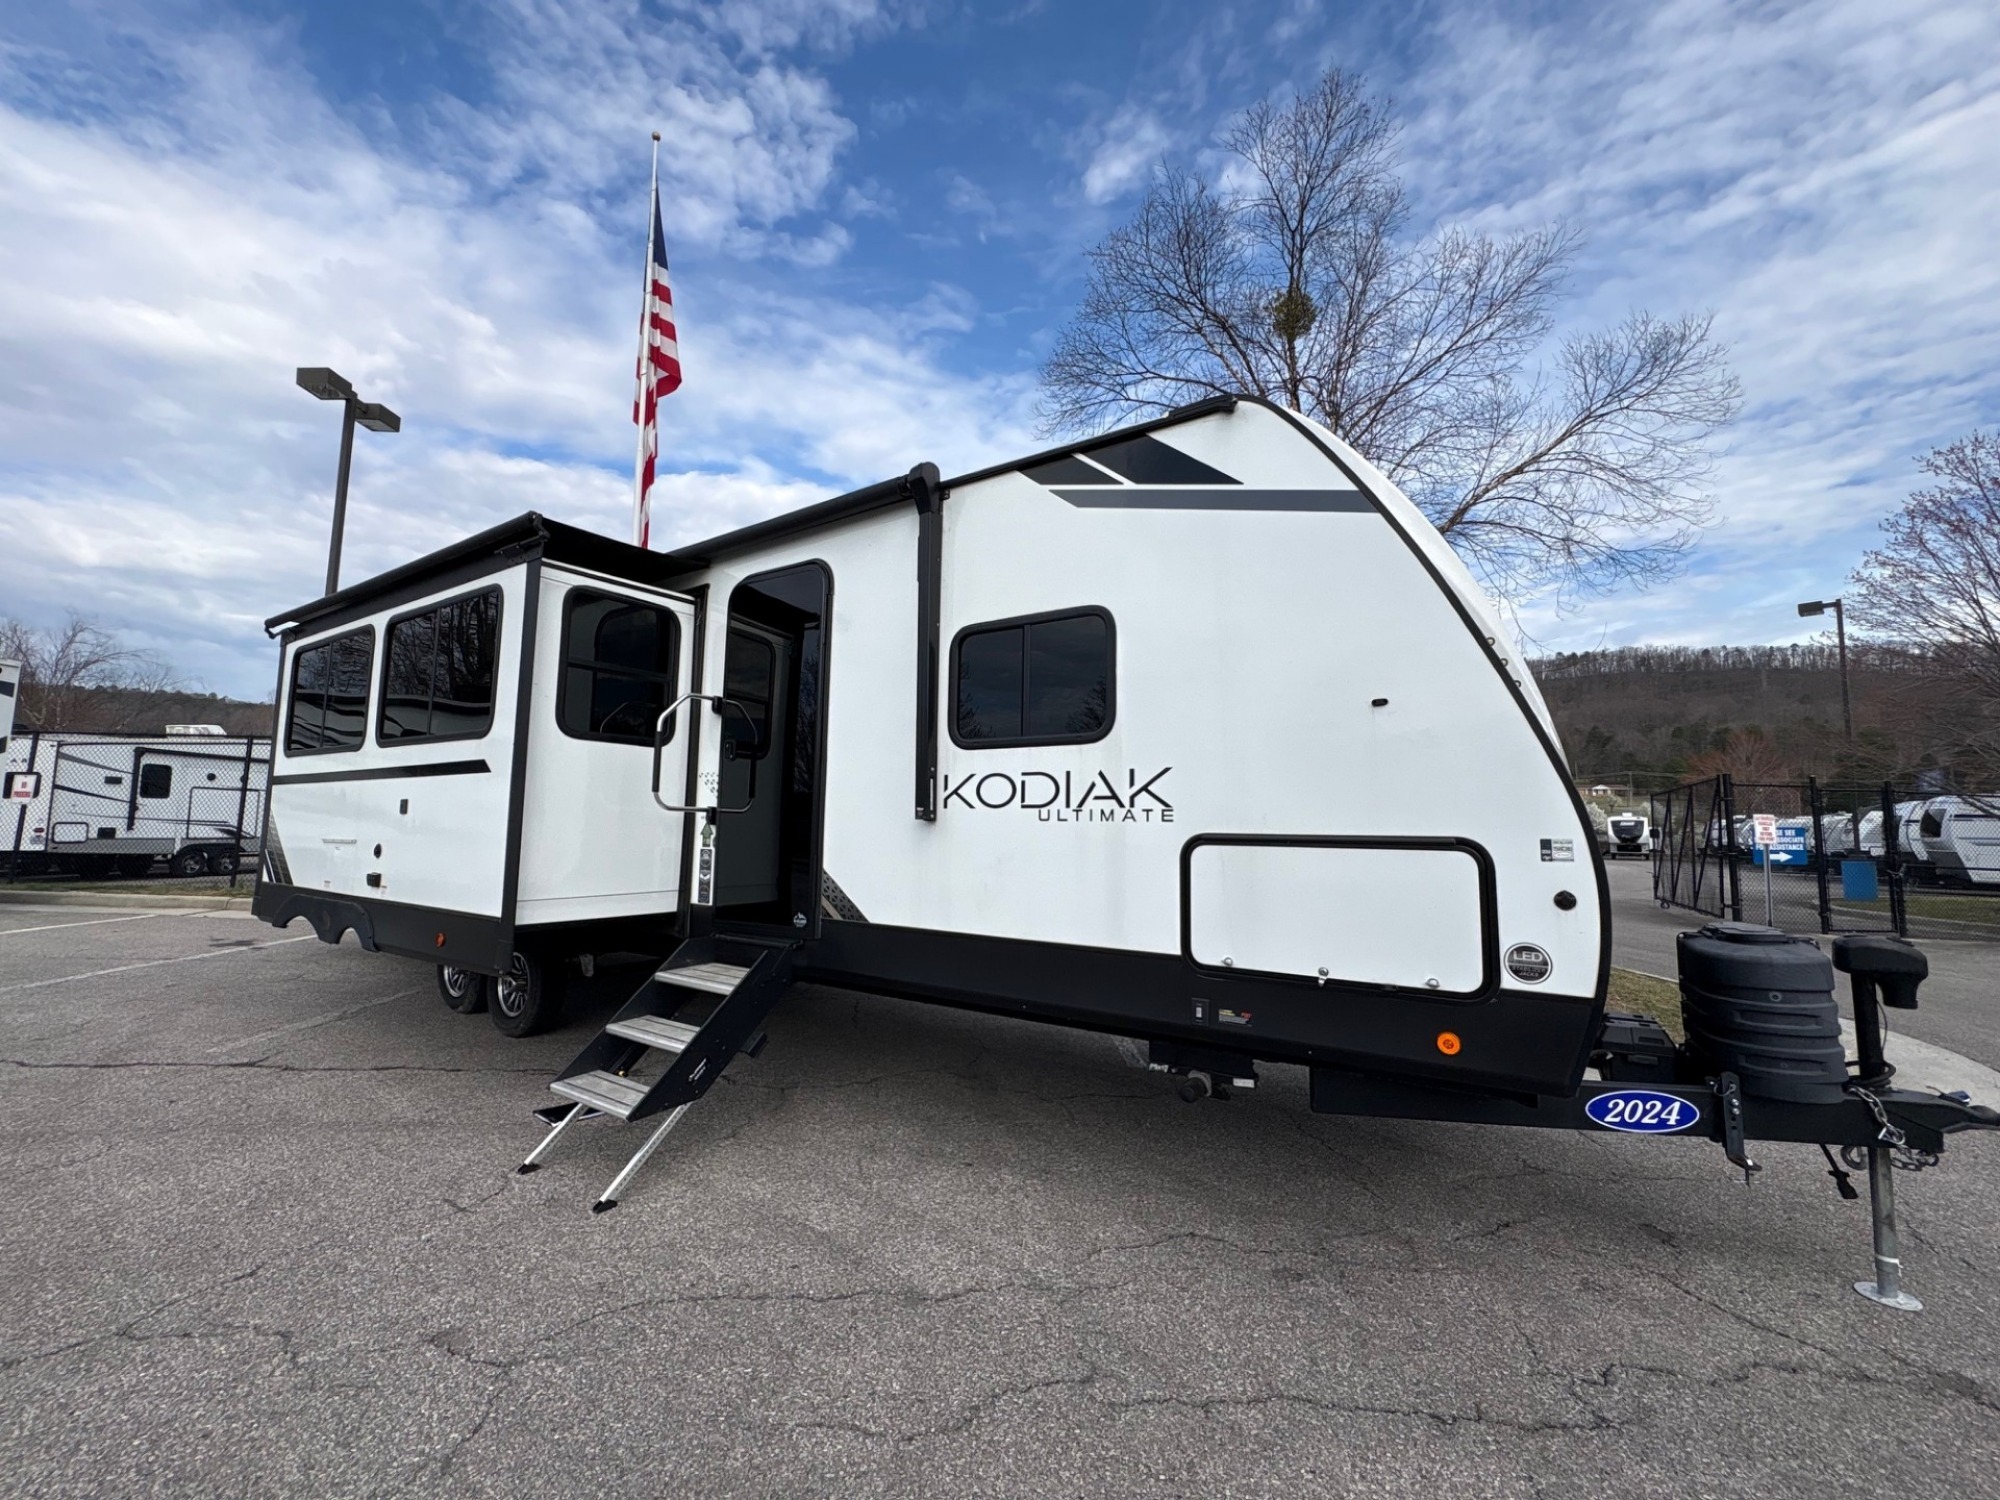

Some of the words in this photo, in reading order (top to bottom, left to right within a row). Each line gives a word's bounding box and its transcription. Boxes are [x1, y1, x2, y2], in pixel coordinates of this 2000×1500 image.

[943, 767, 1173, 809] KODIAK
[1038, 809, 1174, 822] ULTIMATE
[1513, 950, 1543, 962] LED
[1604, 1099, 1681, 1125] 2024
